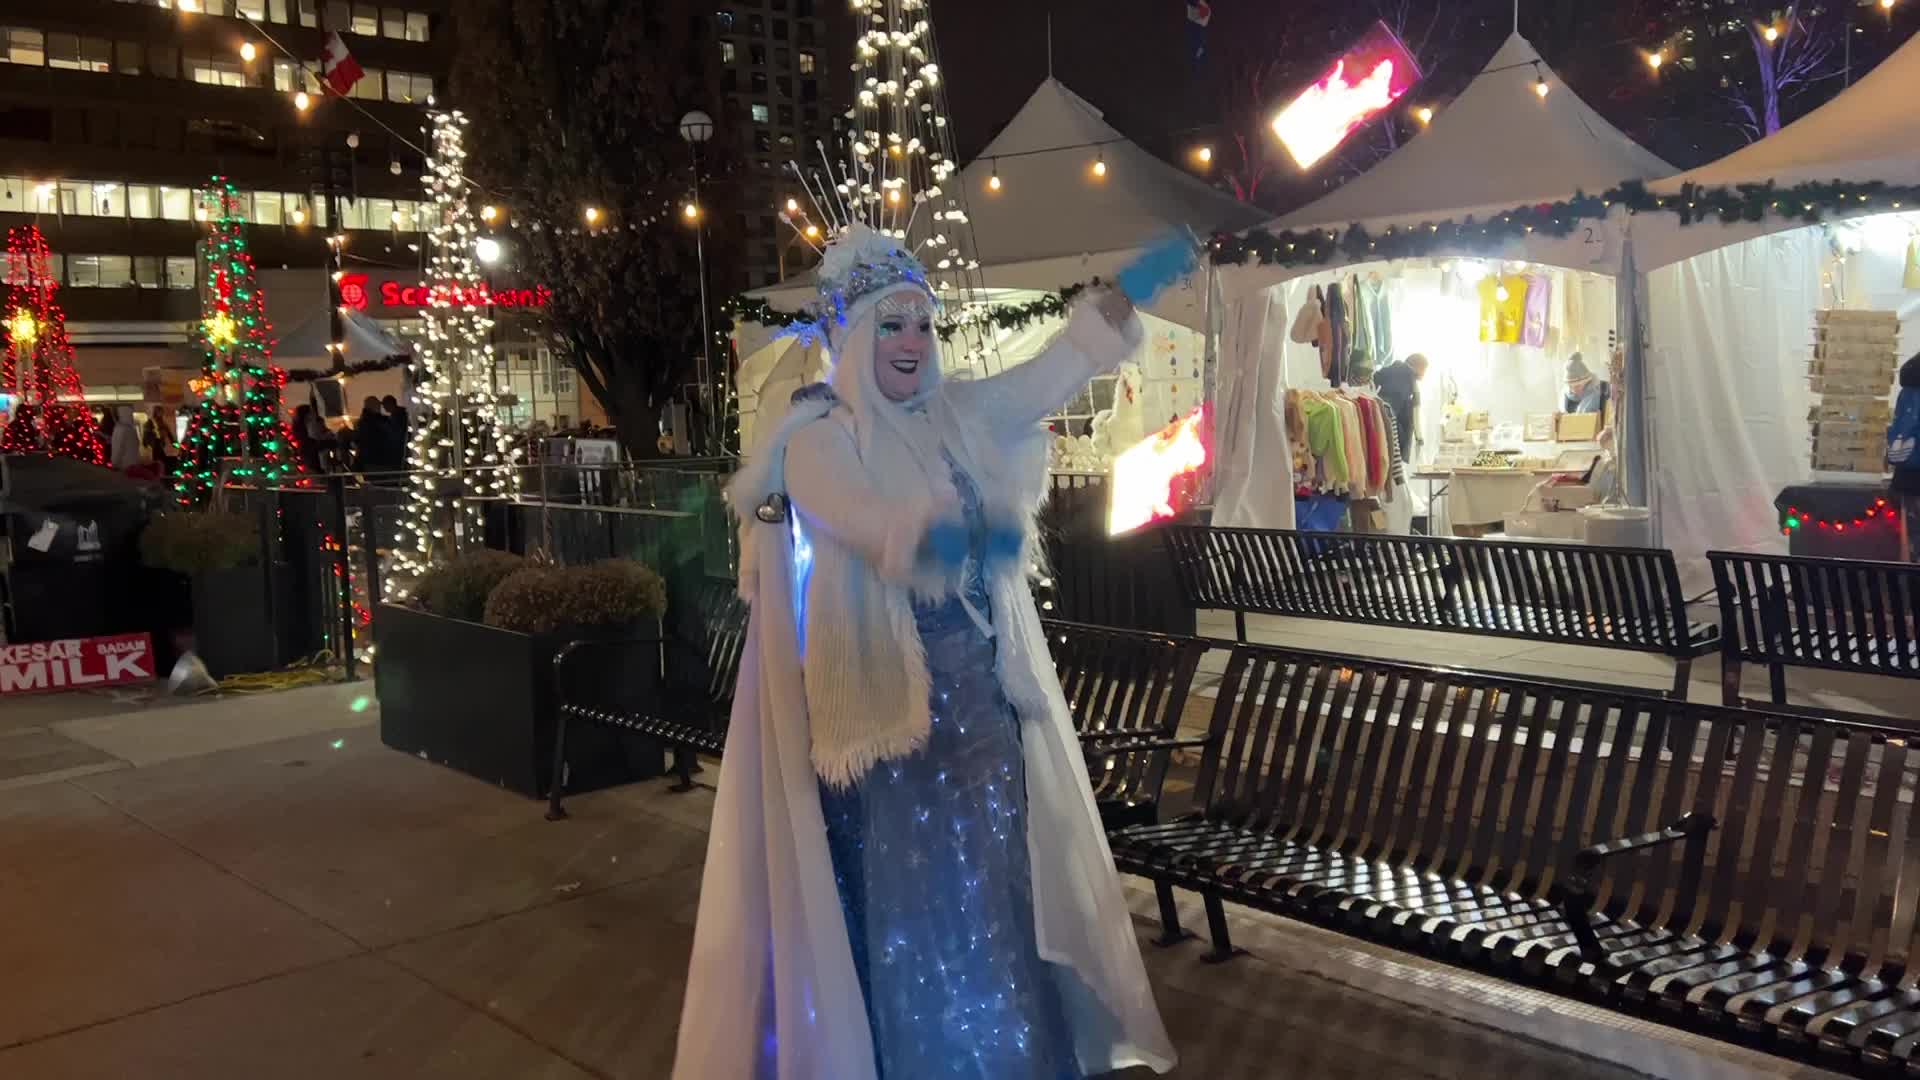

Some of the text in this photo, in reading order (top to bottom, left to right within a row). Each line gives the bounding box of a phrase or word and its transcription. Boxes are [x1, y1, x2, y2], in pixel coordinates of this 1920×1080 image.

[380, 281, 552, 305] Scoiabank
[0, 639, 146, 664] KESAR BADAM
[0, 651, 150, 691] MILK
